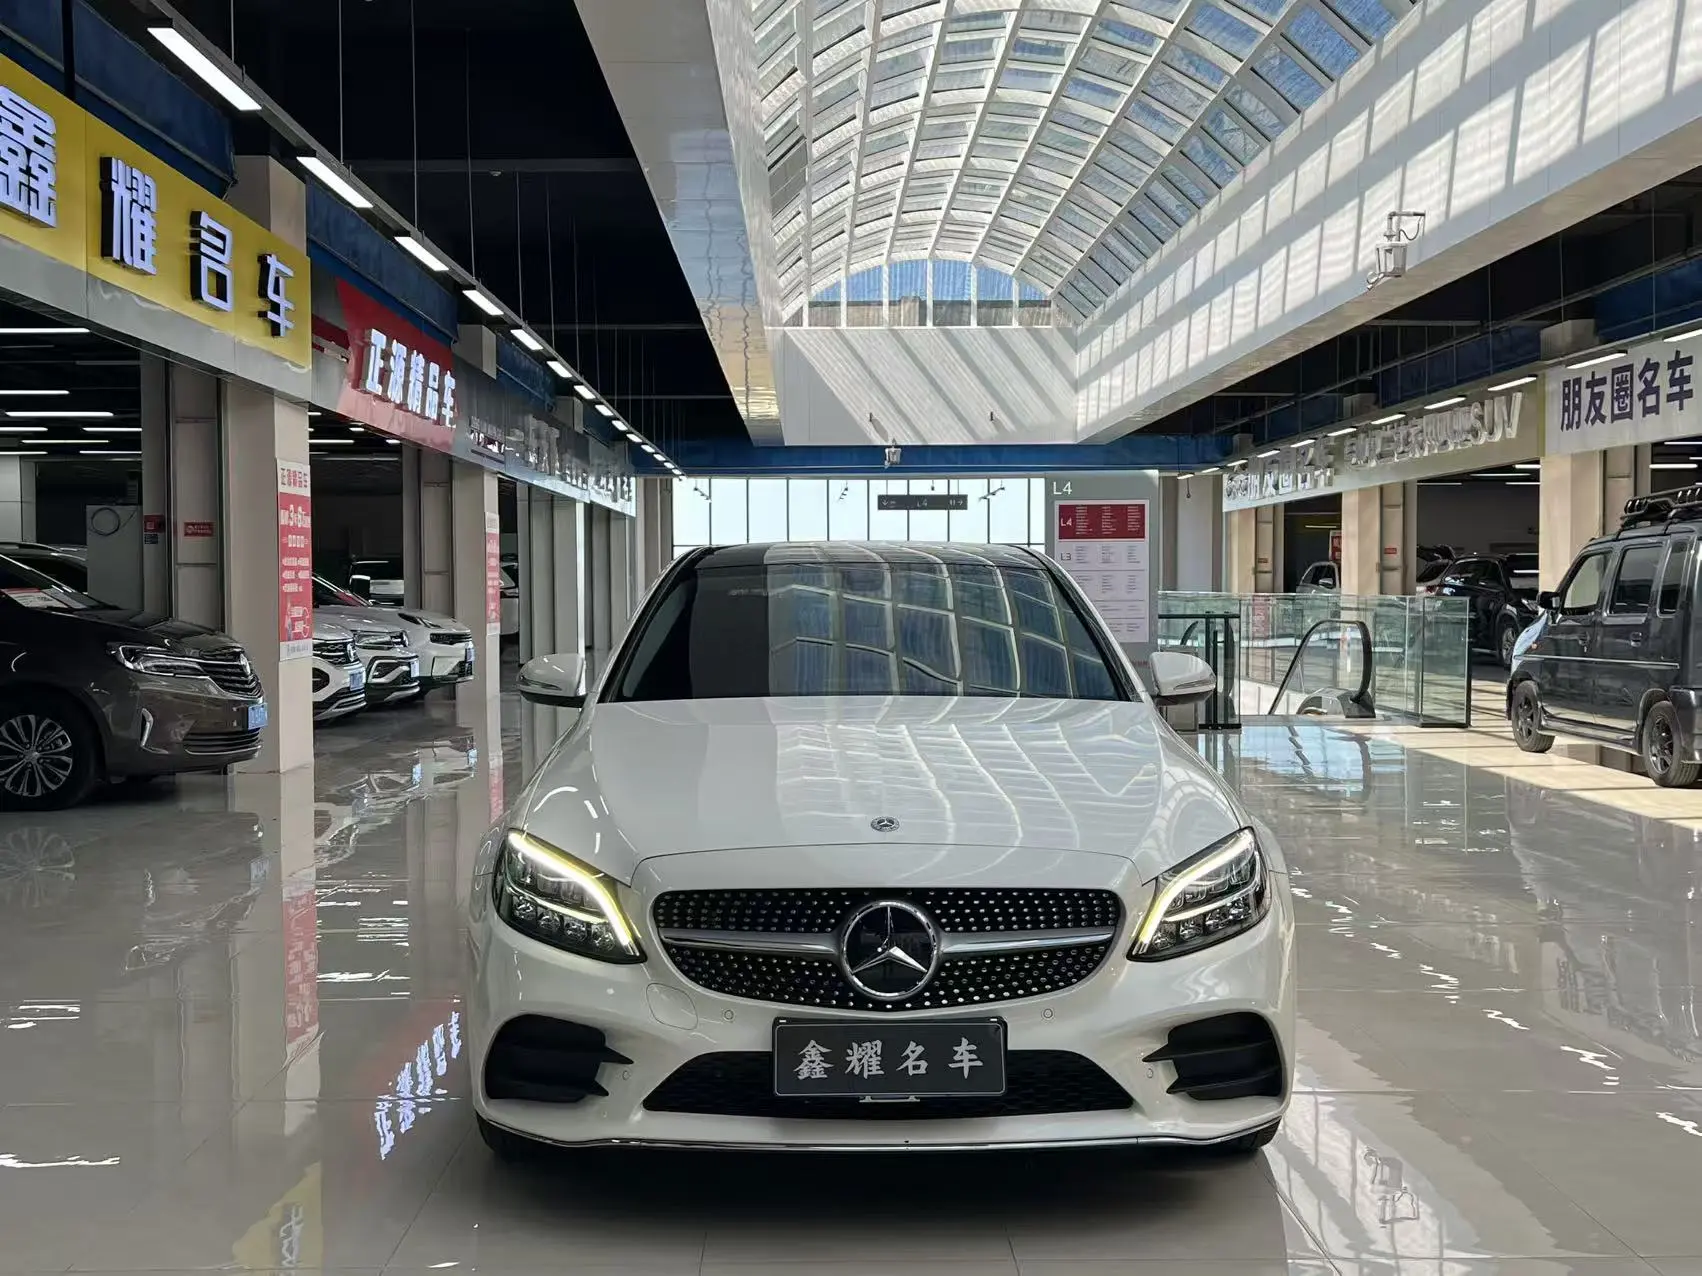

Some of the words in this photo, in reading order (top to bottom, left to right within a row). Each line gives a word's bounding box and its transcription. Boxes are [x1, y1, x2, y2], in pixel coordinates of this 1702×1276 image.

[0, 85, 295, 337] 鑫耀名车
[1561, 349, 1694, 432] 朋友圈名车
[1052, 481, 1073, 495] L4
[1060, 518, 1072, 527] L4
[1060, 553, 1072, 561] L3
[793, 1037, 984, 1079] 鑫耀名车
